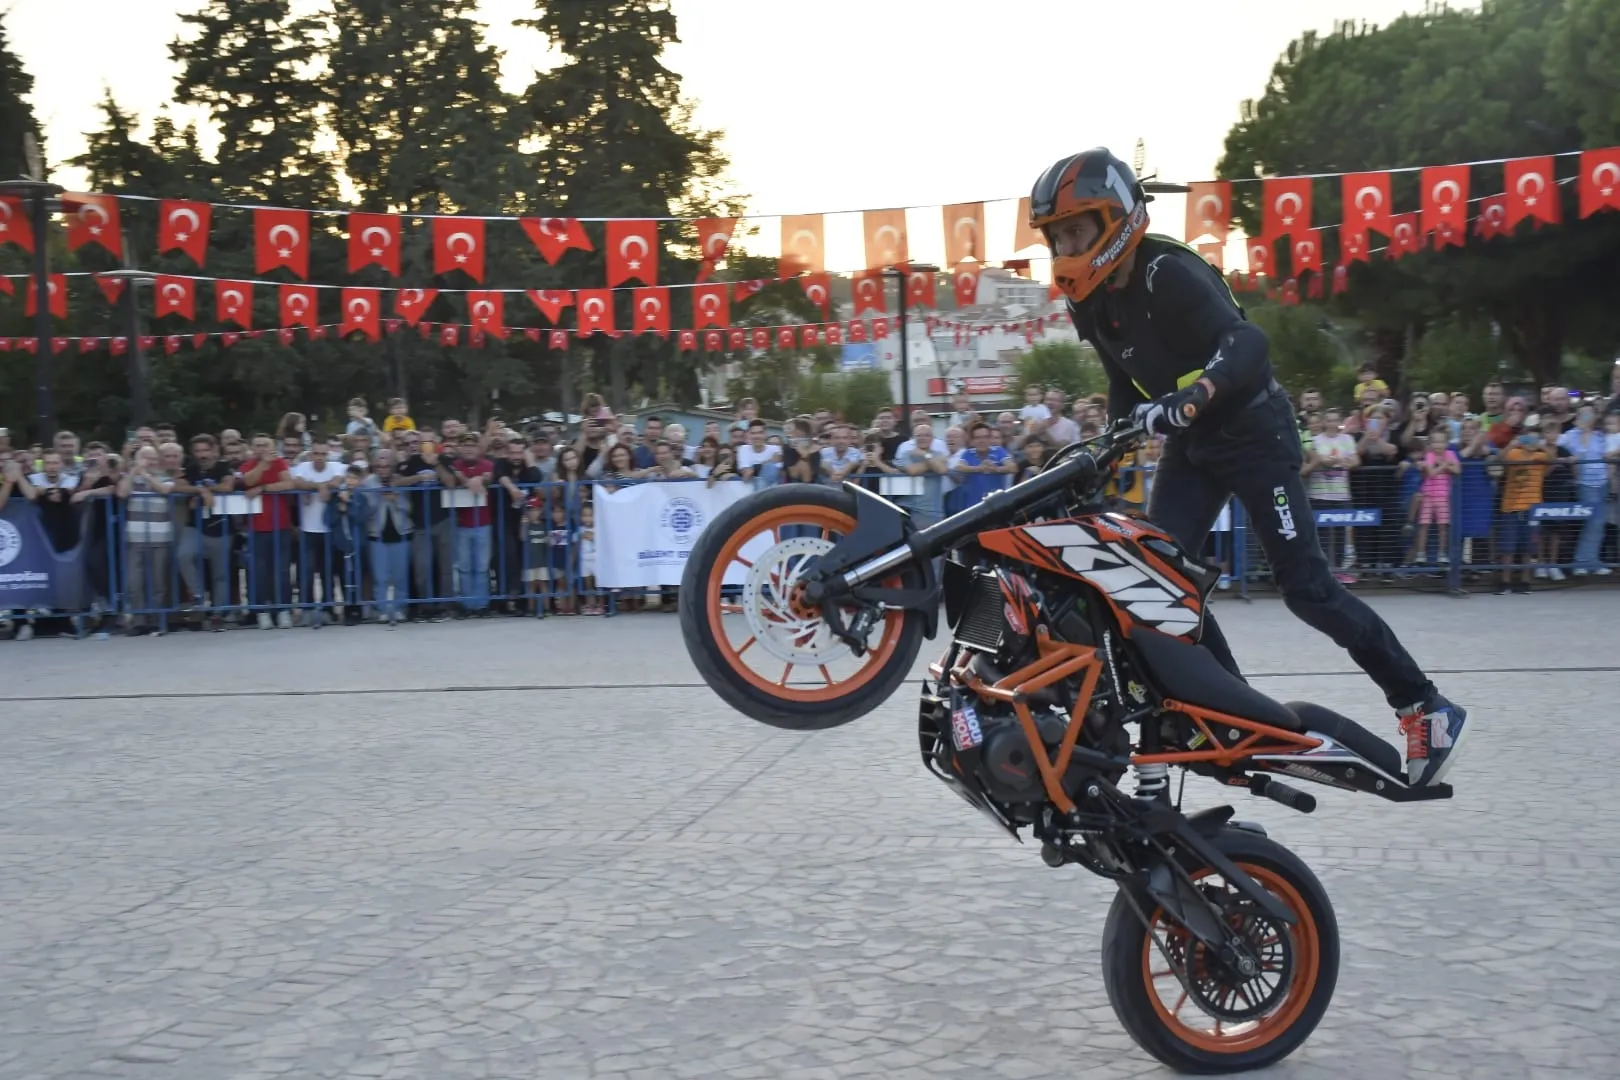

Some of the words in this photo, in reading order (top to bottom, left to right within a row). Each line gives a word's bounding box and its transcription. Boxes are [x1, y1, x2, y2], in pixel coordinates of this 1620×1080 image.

[1317, 510, 1377, 523] POLİS
[1022, 523, 1201, 637] KTM
[952, 711, 974, 749] MOLY
[964, 707, 984, 744] LIQUI
